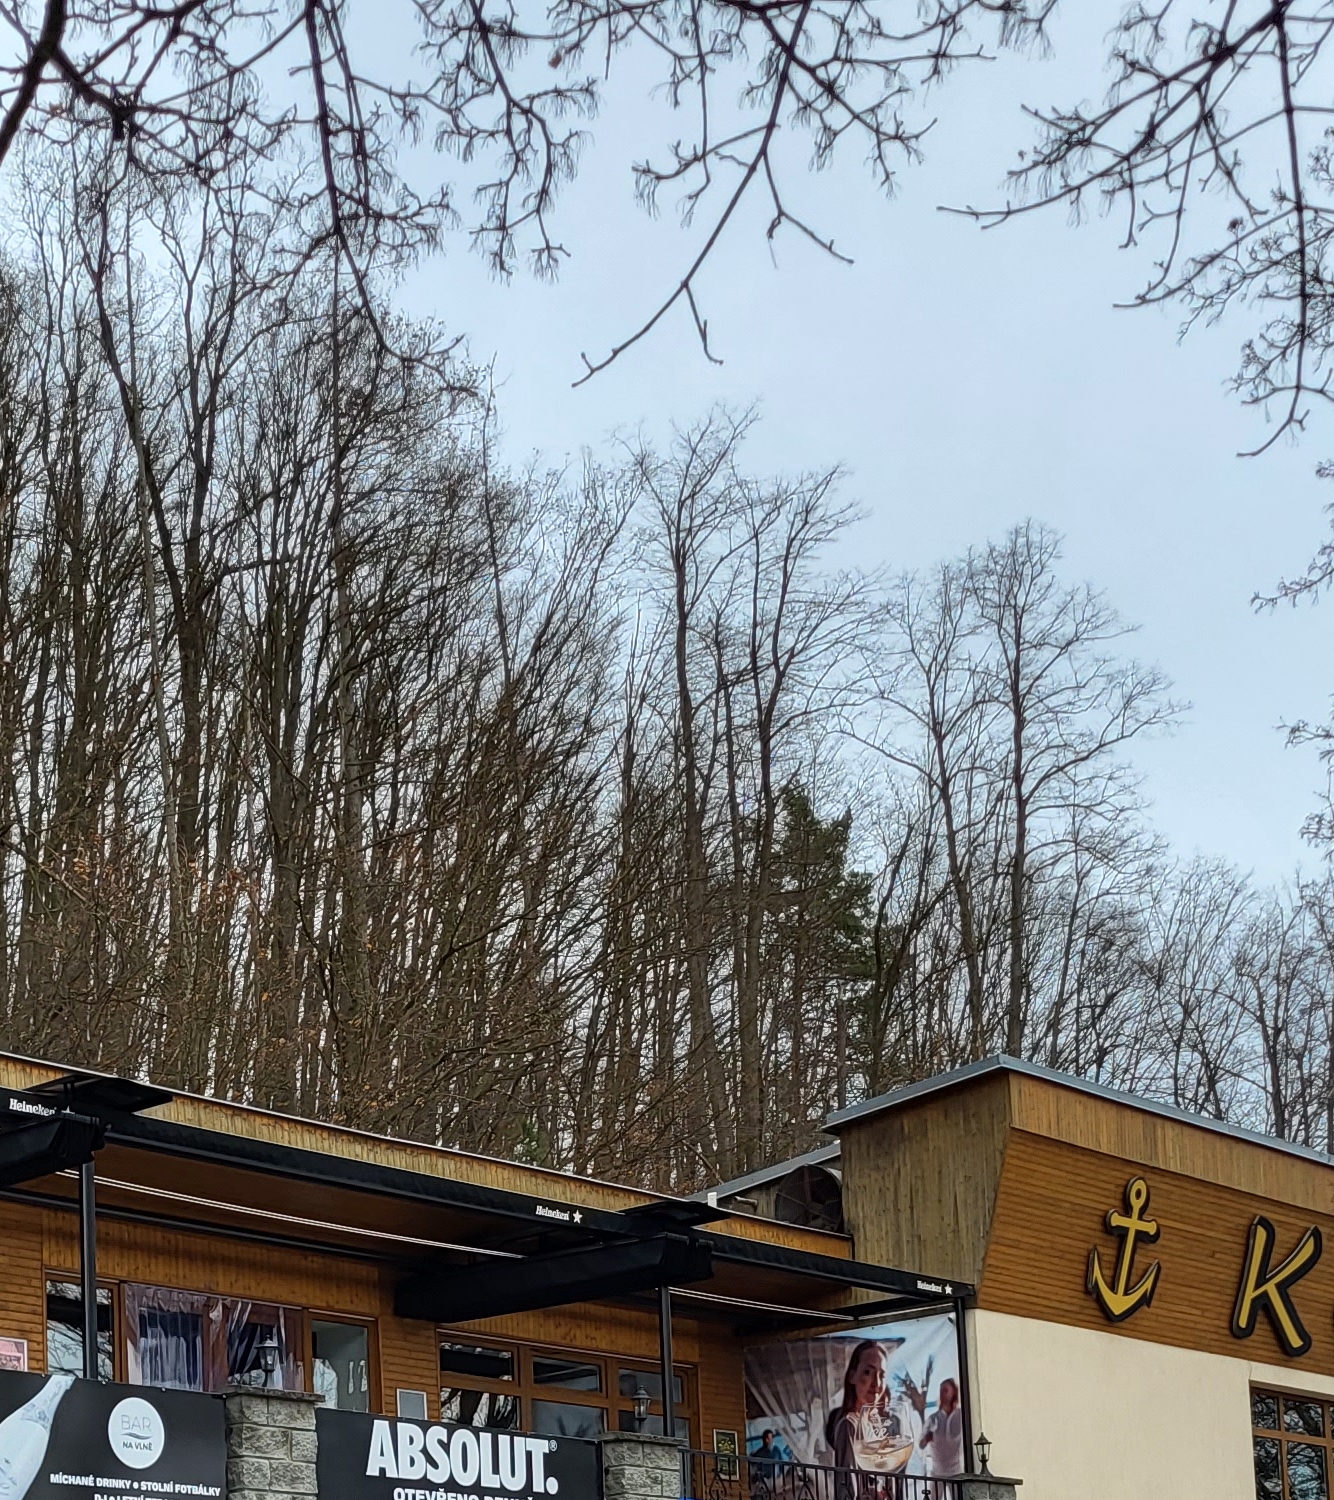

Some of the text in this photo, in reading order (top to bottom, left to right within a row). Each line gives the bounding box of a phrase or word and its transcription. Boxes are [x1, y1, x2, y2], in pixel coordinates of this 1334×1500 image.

[9, 1098, 56, 1117] Heineken
[120, 1414, 153, 1433] BAR
[122, 1440, 153, 1452] NA VLNĚ
[50, 1472, 221, 1497] MÍCHANÉ DRINKY STOLNÍ FOTBÁLKY
